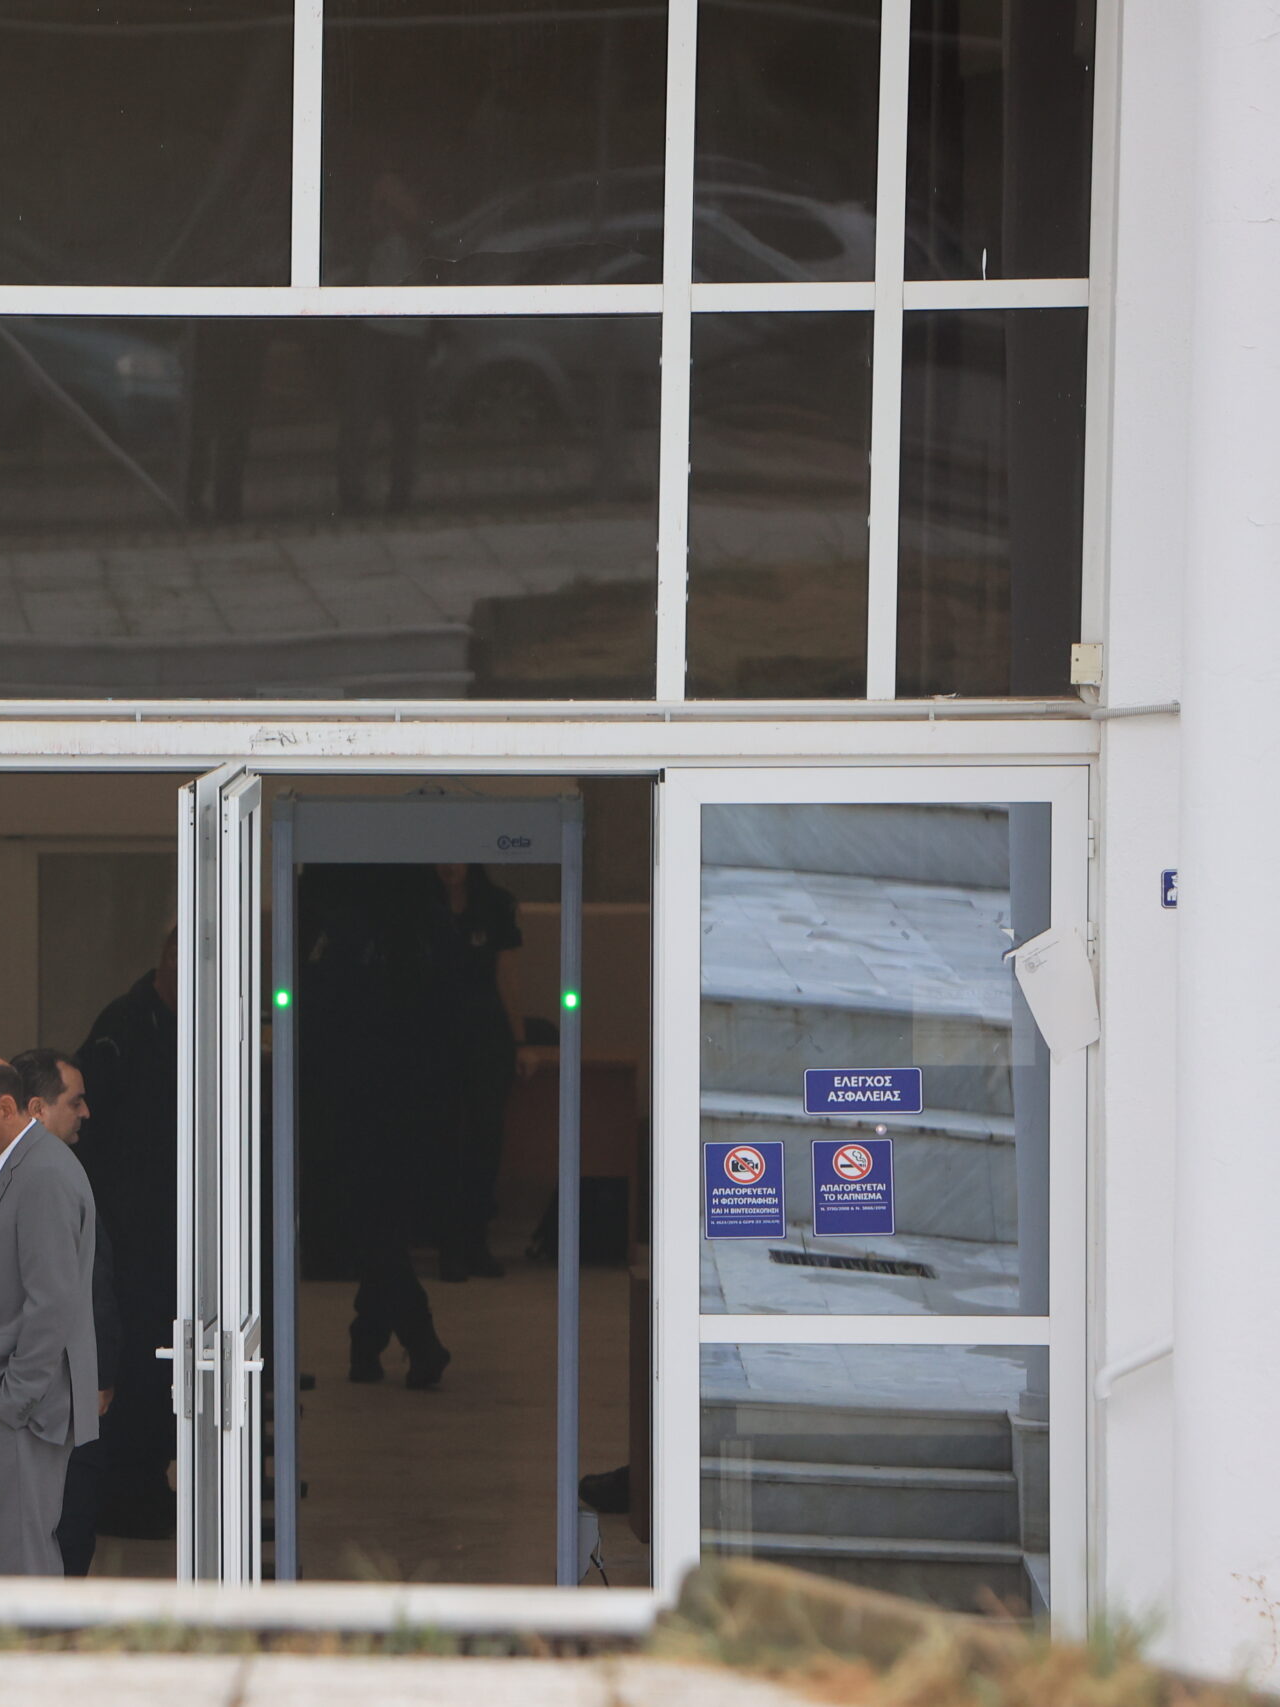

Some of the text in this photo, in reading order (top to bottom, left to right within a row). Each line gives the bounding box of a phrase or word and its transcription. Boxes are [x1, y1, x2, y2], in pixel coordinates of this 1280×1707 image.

[833, 1076, 892, 1087] ΕΛΕΓΧΟΣ
[827, 1090, 901, 1102] ΑΣΦΑΛΕΙΑΣ
[712, 1187, 776, 1196] ΑΠΑΓΟΡΕΥΕΤΑΙ
[820, 1183, 886, 1193] ΑΠΑΓΟΡΕΥΕΤΑΙ
[712, 1197, 779, 1205] Η ΦΩΤΟΓΡΑΦΗΣΗ
[823, 1193, 883, 1201] ΤΟ ΚΑΠΝΙΣΜΑ
